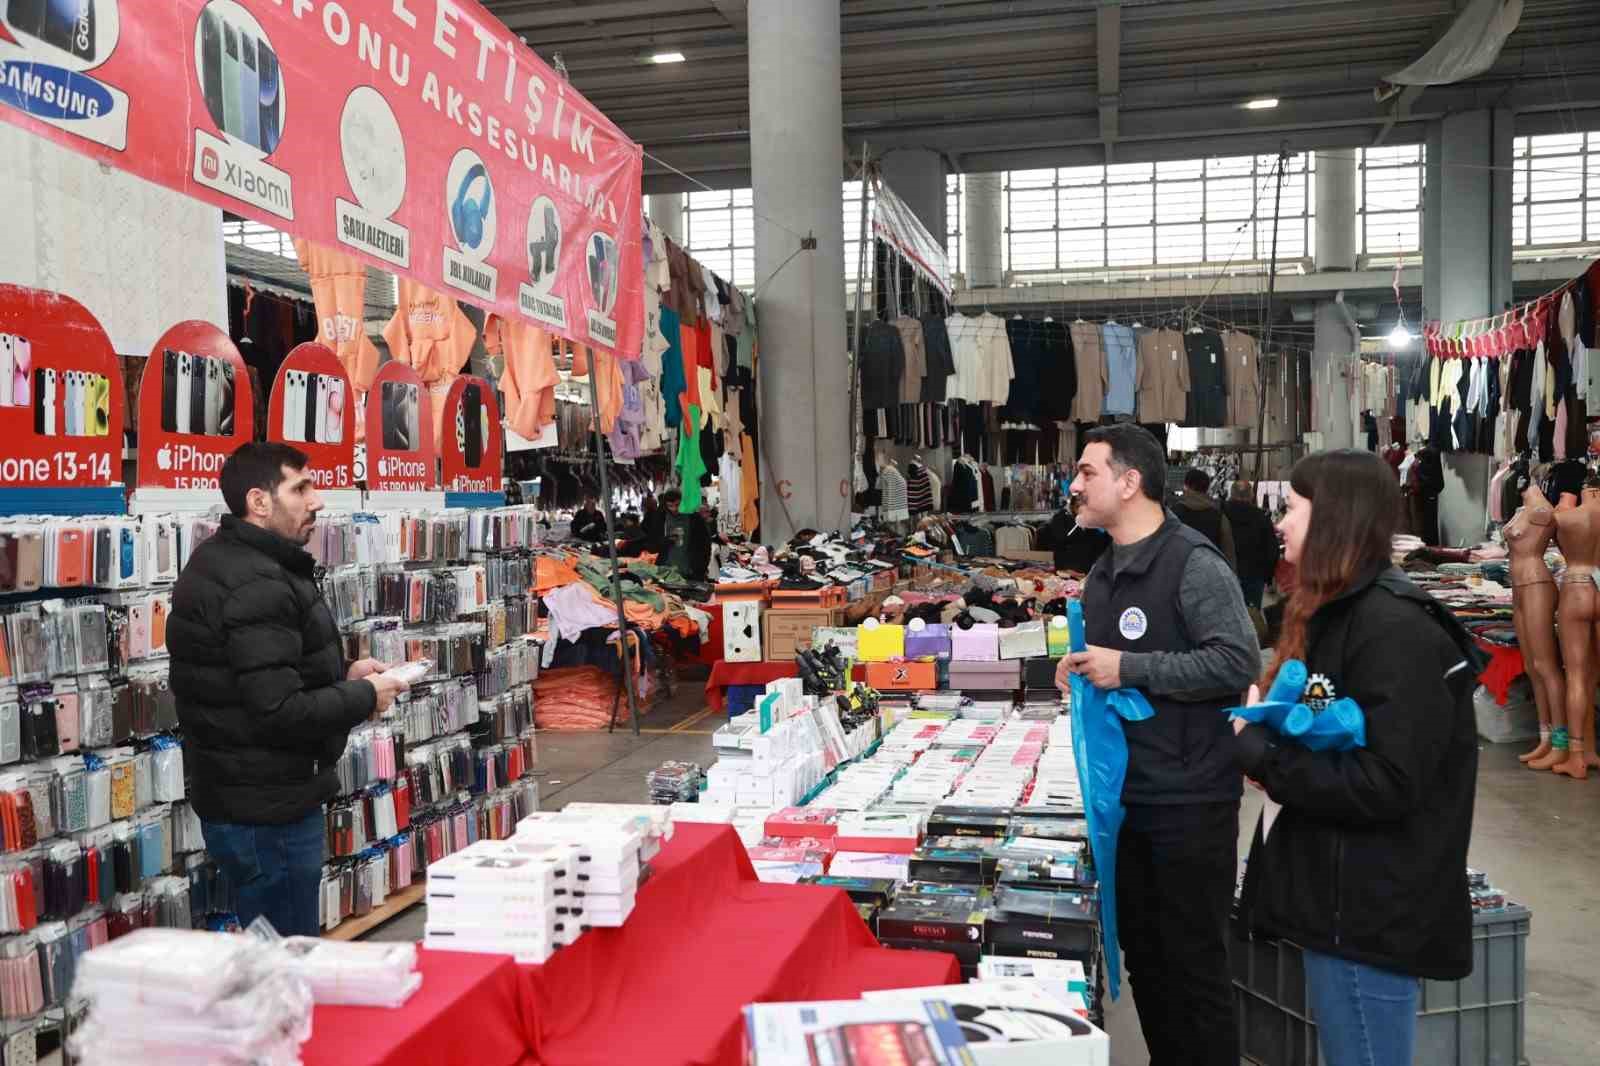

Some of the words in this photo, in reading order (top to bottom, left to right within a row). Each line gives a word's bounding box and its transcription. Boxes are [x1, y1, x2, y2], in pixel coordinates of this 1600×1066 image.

[422, 71, 618, 224] AKSESUARLARI
[0, 457, 50, 481] one
[53, 451, 112, 481] 13-14
[173, 444, 226, 472] iPhon
[387, 456, 426, 477] iPhone
[309, 468, 334, 486] one
[335, 464, 348, 486] 15
